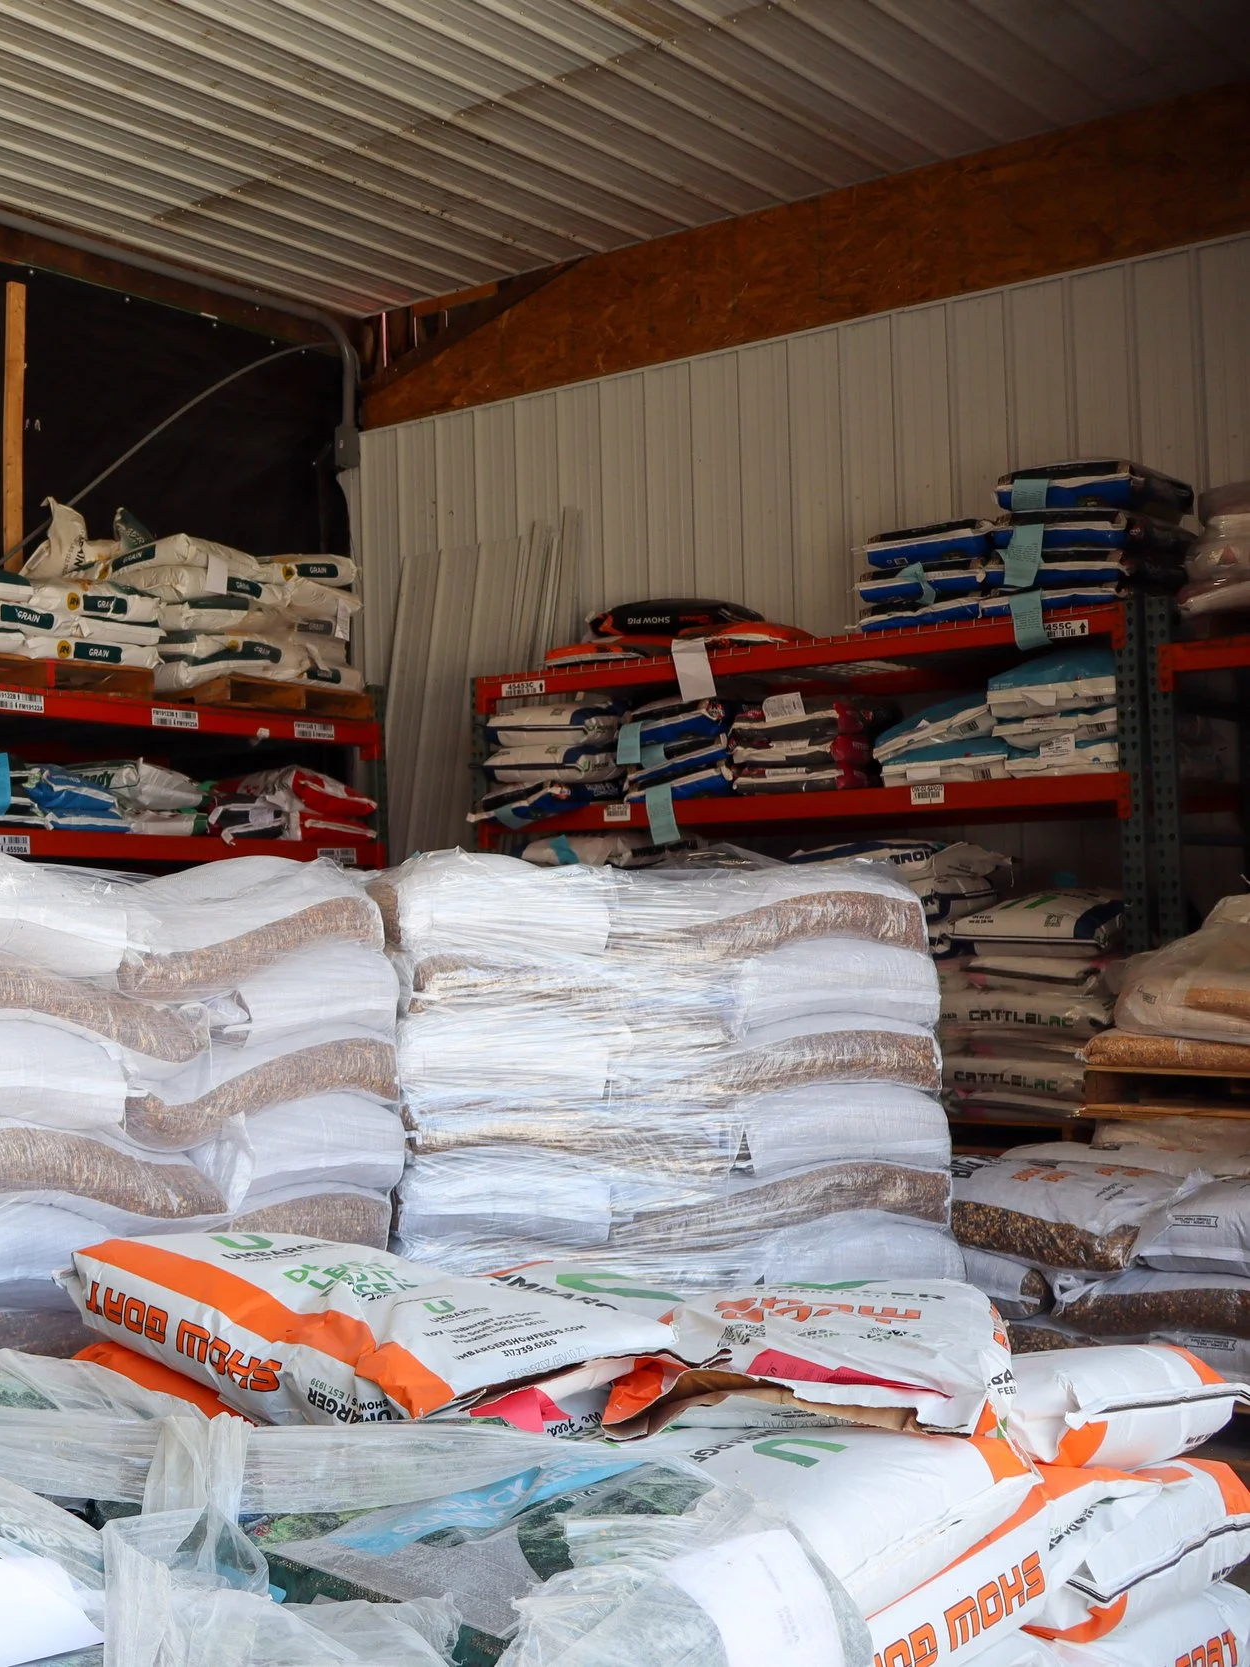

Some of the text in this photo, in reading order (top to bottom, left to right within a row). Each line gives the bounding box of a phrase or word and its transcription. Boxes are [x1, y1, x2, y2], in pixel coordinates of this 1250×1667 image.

[16, 610, 41, 624] GRAIN
[627, 616, 641, 625] PIG
[642, 616, 670, 624] SHOW
[1043, 622, 1072, 632] 455C
[88, 648, 109, 658] GRAIN
[508, 682, 534, 691] 45453C
[968, 1009, 1074, 1028] CATTLELAC
[953, 1071, 1058, 1093] CATTLELAC
[444, 1318, 494, 1334] Umbarger
[87, 1281, 283, 1392] SHOW GOAT
[453, 1324, 587, 1361] UMBARGERSHOWFEEDS.COM
[501, 1338, 558, 1357] 317.739.6565
[310, 1378, 345, 1400] EST. 1939
[358, 1398, 389, 1411] SHOW
[547, 1419, 584, 1437] Feed
[943, 1550, 1046, 1653] SHOW
